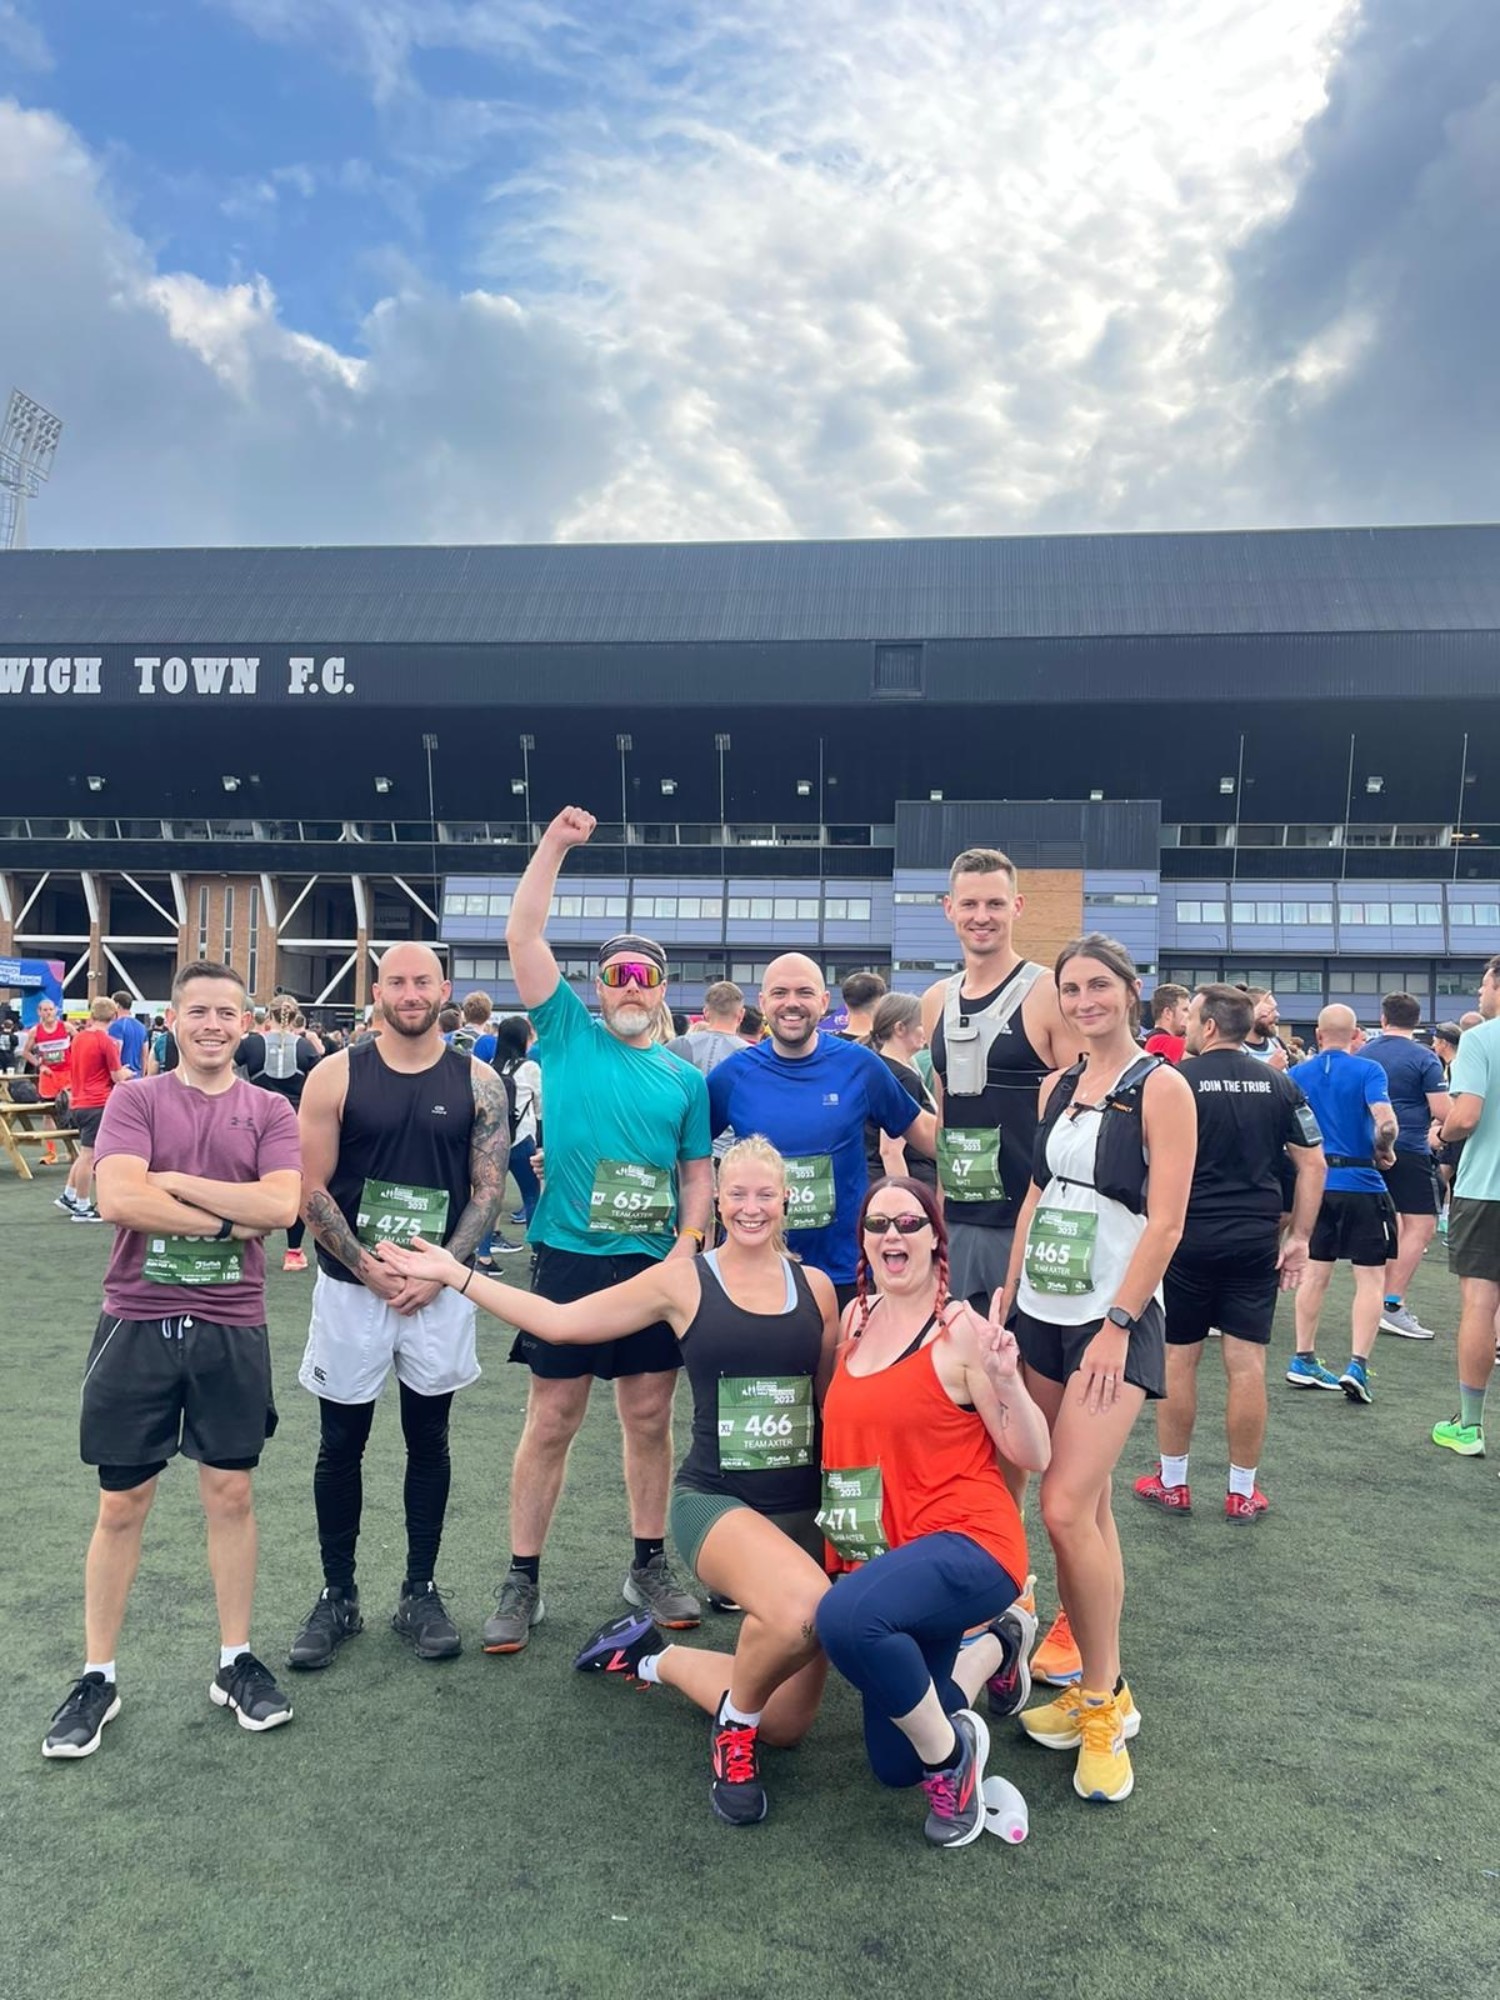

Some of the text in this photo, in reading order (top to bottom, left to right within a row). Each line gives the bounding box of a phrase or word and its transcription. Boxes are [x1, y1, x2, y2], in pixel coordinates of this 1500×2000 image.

[0, 657, 355, 694] WICH TOWN F.C.
[1199, 1080, 1271, 1093] JOIN THE TRIBE
[952, 1159, 974, 1176] 47
[613, 1191, 654, 1211] 657
[788, 1186, 816, 1205] 86
[611, 1209, 631, 1218] TEAM
[376, 1215, 422, 1236] 475
[1034, 1241, 1071, 1265] 465
[773, 1395, 796, 1405] 2023
[720, 1424, 731, 1433] XL
[744, 1413, 793, 1437] 466
[744, 1438, 794, 1449] TEAM AXTER
[840, 1488, 862, 1497] 2023
[826, 1507, 858, 1531] 471
